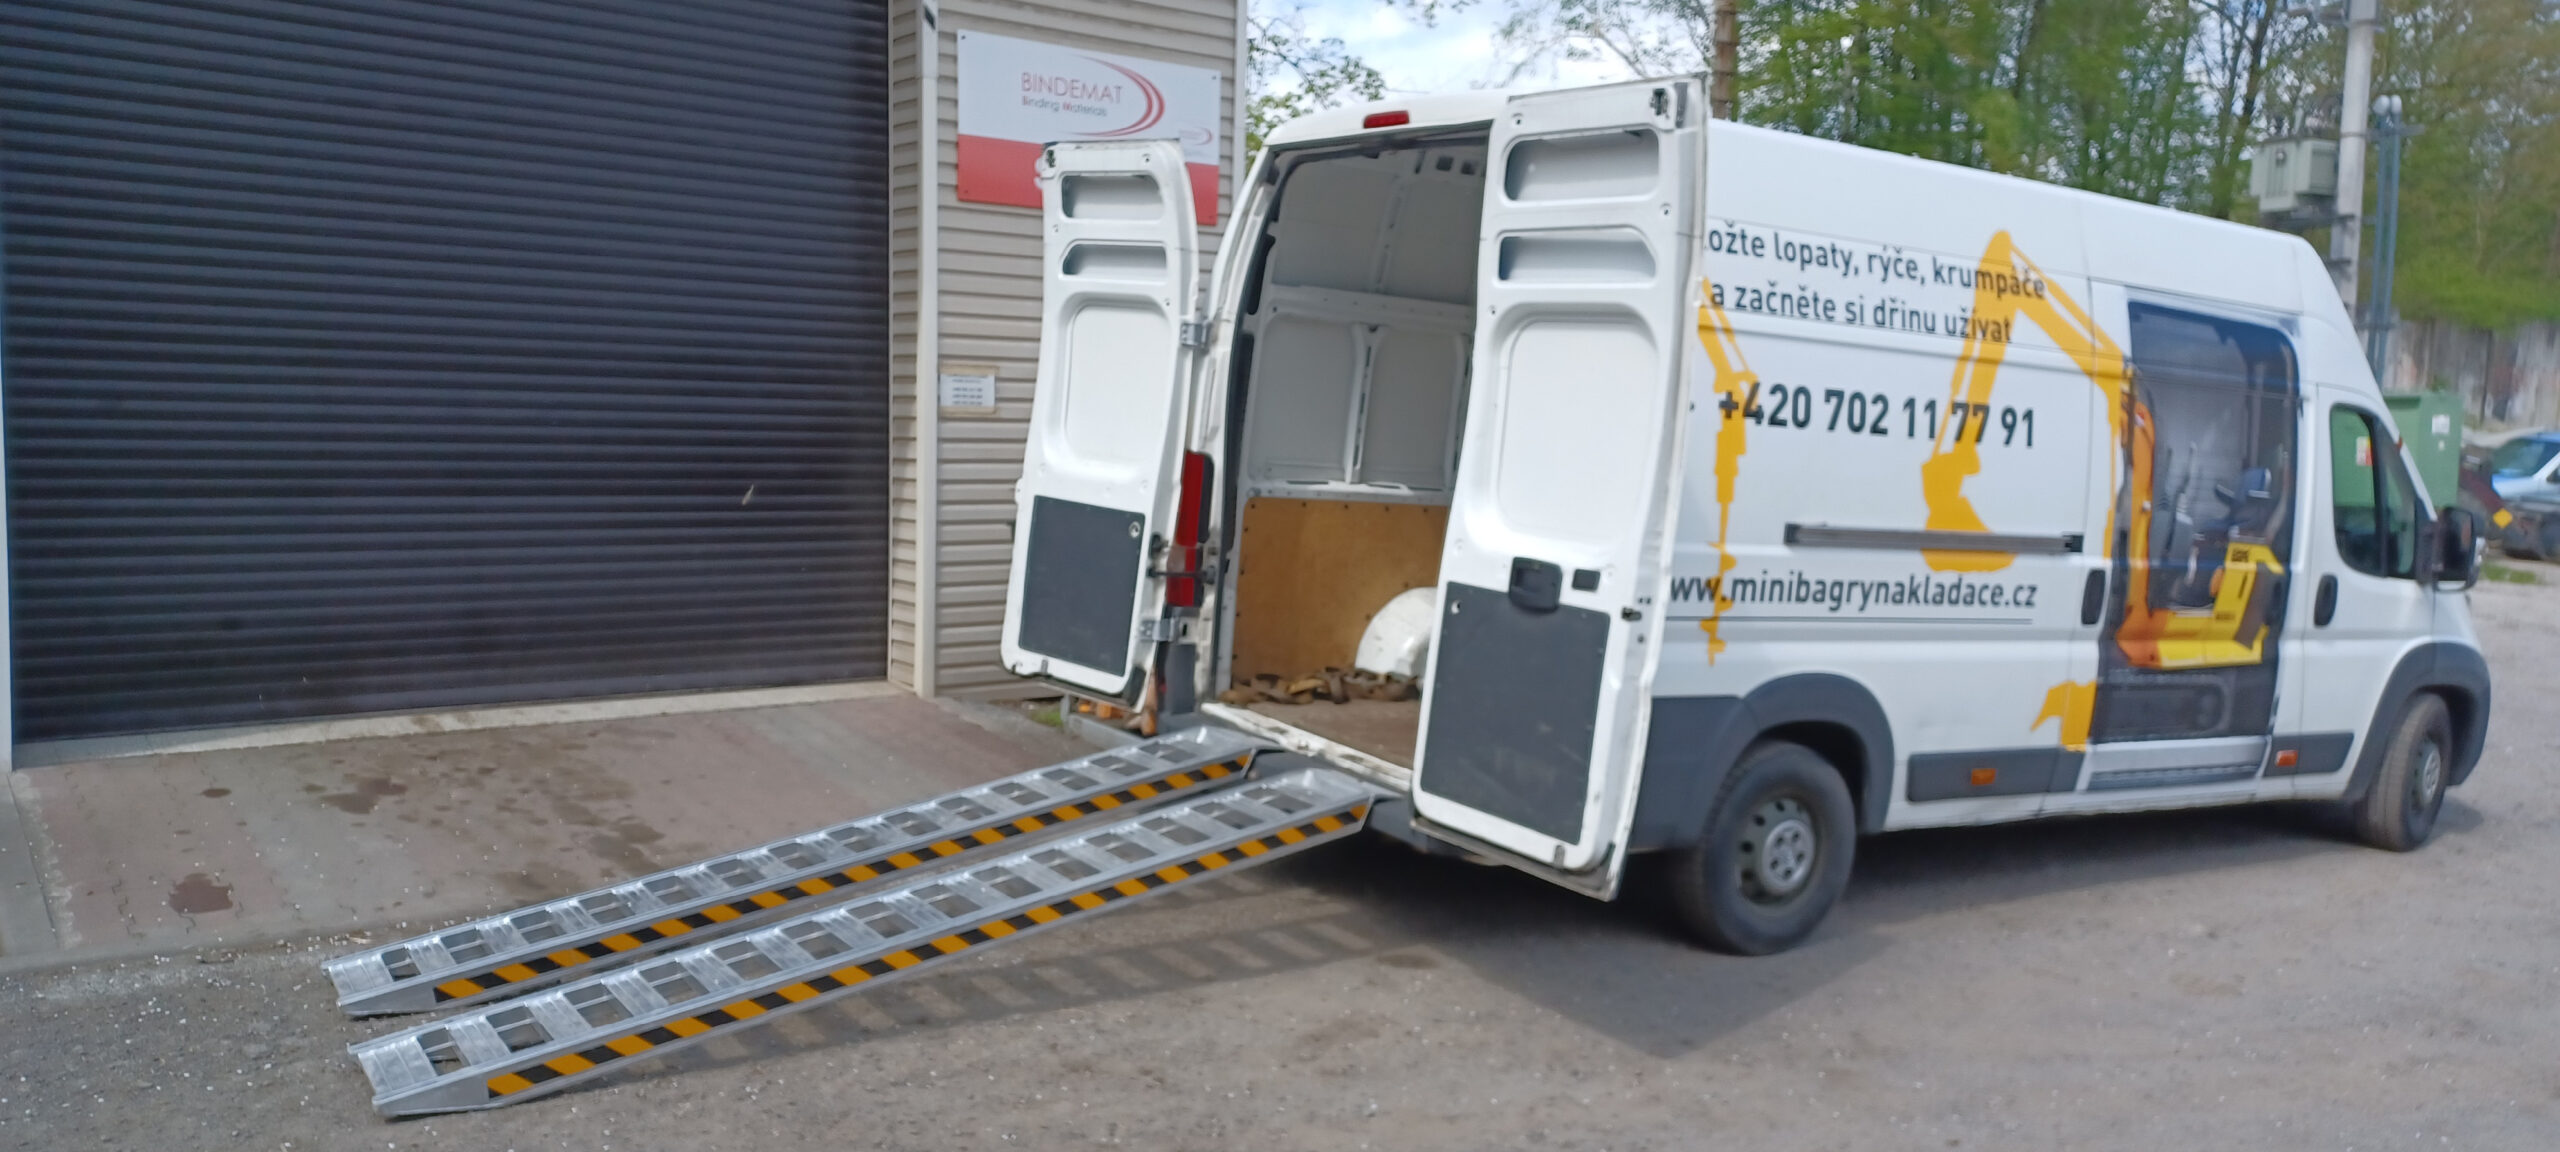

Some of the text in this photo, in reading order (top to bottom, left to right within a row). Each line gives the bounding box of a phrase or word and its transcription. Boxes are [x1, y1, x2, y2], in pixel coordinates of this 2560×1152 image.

[1021, 72, 1122, 104] BINDEMAT
[1022, 95, 1107, 117] Binding Materials
[1774, 232, 1859, 277] lopaty,
[1867, 244, 1925, 286] rýče,
[1932, 255, 2046, 299] krumpáče
[1711, 283, 1725, 306] a
[1734, 279, 1836, 322] začněte
[1845, 294, 1865, 326] si
[1873, 297, 1937, 334] dřinu
[1718, 381, 2034, 448] +420 702 11 77 91
